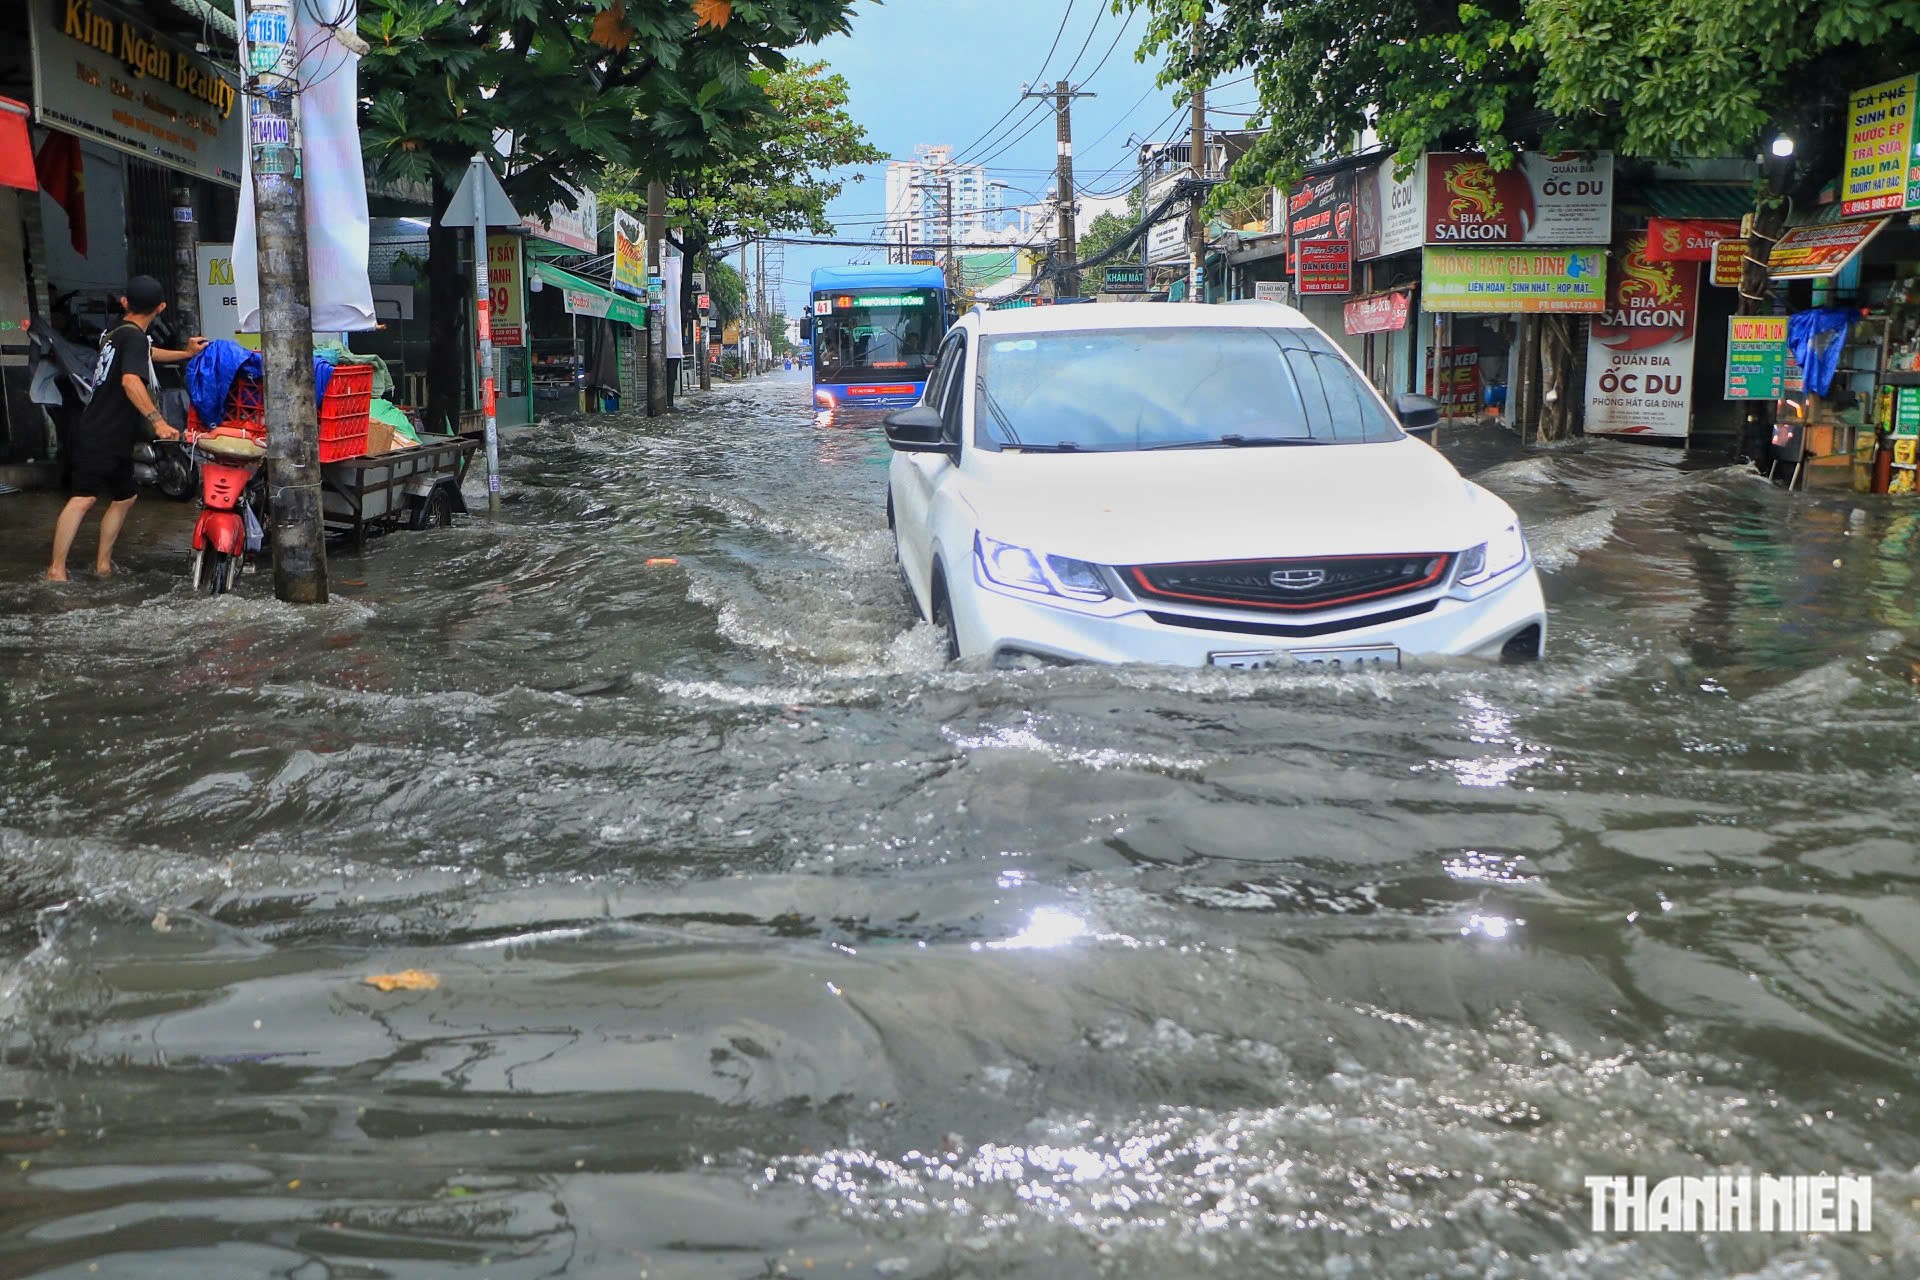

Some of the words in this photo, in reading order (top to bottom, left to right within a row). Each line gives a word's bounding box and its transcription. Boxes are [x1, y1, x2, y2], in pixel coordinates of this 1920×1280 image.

[64, 0, 115, 55] Kim
[120, 22, 173, 79] Ngân
[175, 55, 237, 119] Beauty
[1857, 93, 1874, 109] CÀ
[1855, 109, 1885, 127] SINH
[1853, 126, 1885, 144] NƯỚC
[1888, 122, 1905, 136] ÉP
[1852, 145, 1874, 160] TRÀ
[1878, 139, 1903, 156] SỮA
[1552, 164, 1577, 173] QUÁN
[1580, 165, 1594, 173] BIA
[1851, 164, 1874, 178] RAU
[1879, 158, 1900, 173] MÁ
[1543, 176, 1571, 196] ỐC
[1576, 180, 1603, 196] DU
[1402, 184, 1412, 207] DU
[1887, 194, 1903, 208] 277
[1460, 213, 1482, 223] BIA
[1435, 223, 1507, 240] SAIGON
[1326, 245, 1347, 254] 555
[1686, 236, 1716, 249] SAIG
[497, 240, 515, 262] SẤY
[1337, 262, 1348, 271] XE
[1479, 251, 1505, 275] HÁT
[1508, 255, 1530, 276] GIA
[1533, 251, 1566, 276] ĐÌNH
[1107, 271, 1127, 282] KHÁM
[1128, 269, 1144, 282] MẮT
[1468, 280, 1484, 292] LIÊN
[1486, 283, 1505, 292] HOAN
[1512, 282, 1530, 293] SINH
[1531, 282, 1551, 294] NHẬT
[817, 302, 828, 314] 41
[1630, 296, 1656, 308] BIA
[1601, 309, 1685, 327] SAIGON
[1612, 354, 1647, 366] QUÁN
[1651, 356, 1670, 366] BIA
[1599, 367, 1638, 393] ỐC
[1645, 374, 1682, 395] DU
[1592, 395, 1624, 406] PHÒNG
[1626, 396, 1642, 407] HÁT
[1644, 399, 1659, 408] GIA
[1662, 397, 1684, 408] ĐÌNH
